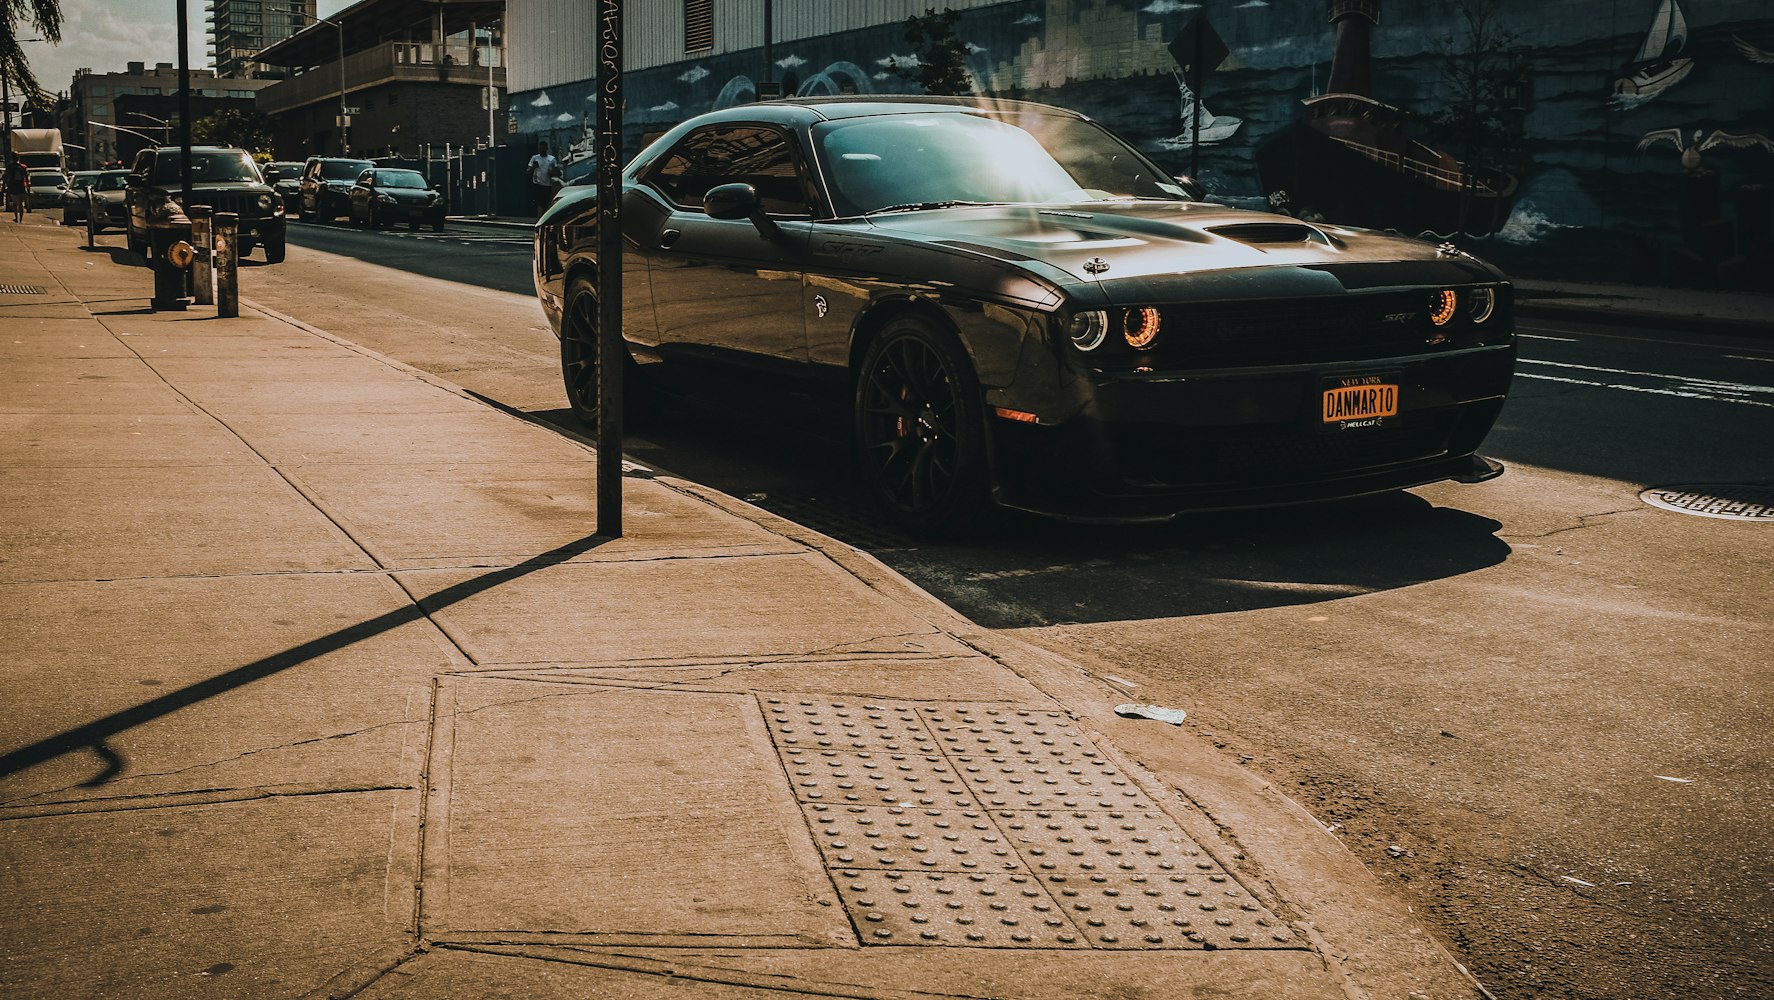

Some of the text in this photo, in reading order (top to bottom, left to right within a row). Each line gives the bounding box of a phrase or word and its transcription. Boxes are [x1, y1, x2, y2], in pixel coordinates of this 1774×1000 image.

[1382, 312, 1417, 323] SRT
[1341, 376, 1382, 387] NEW YORK
[1327, 387, 1393, 418] DANMAR10
[1346, 419, 1376, 428] HELLCAT
